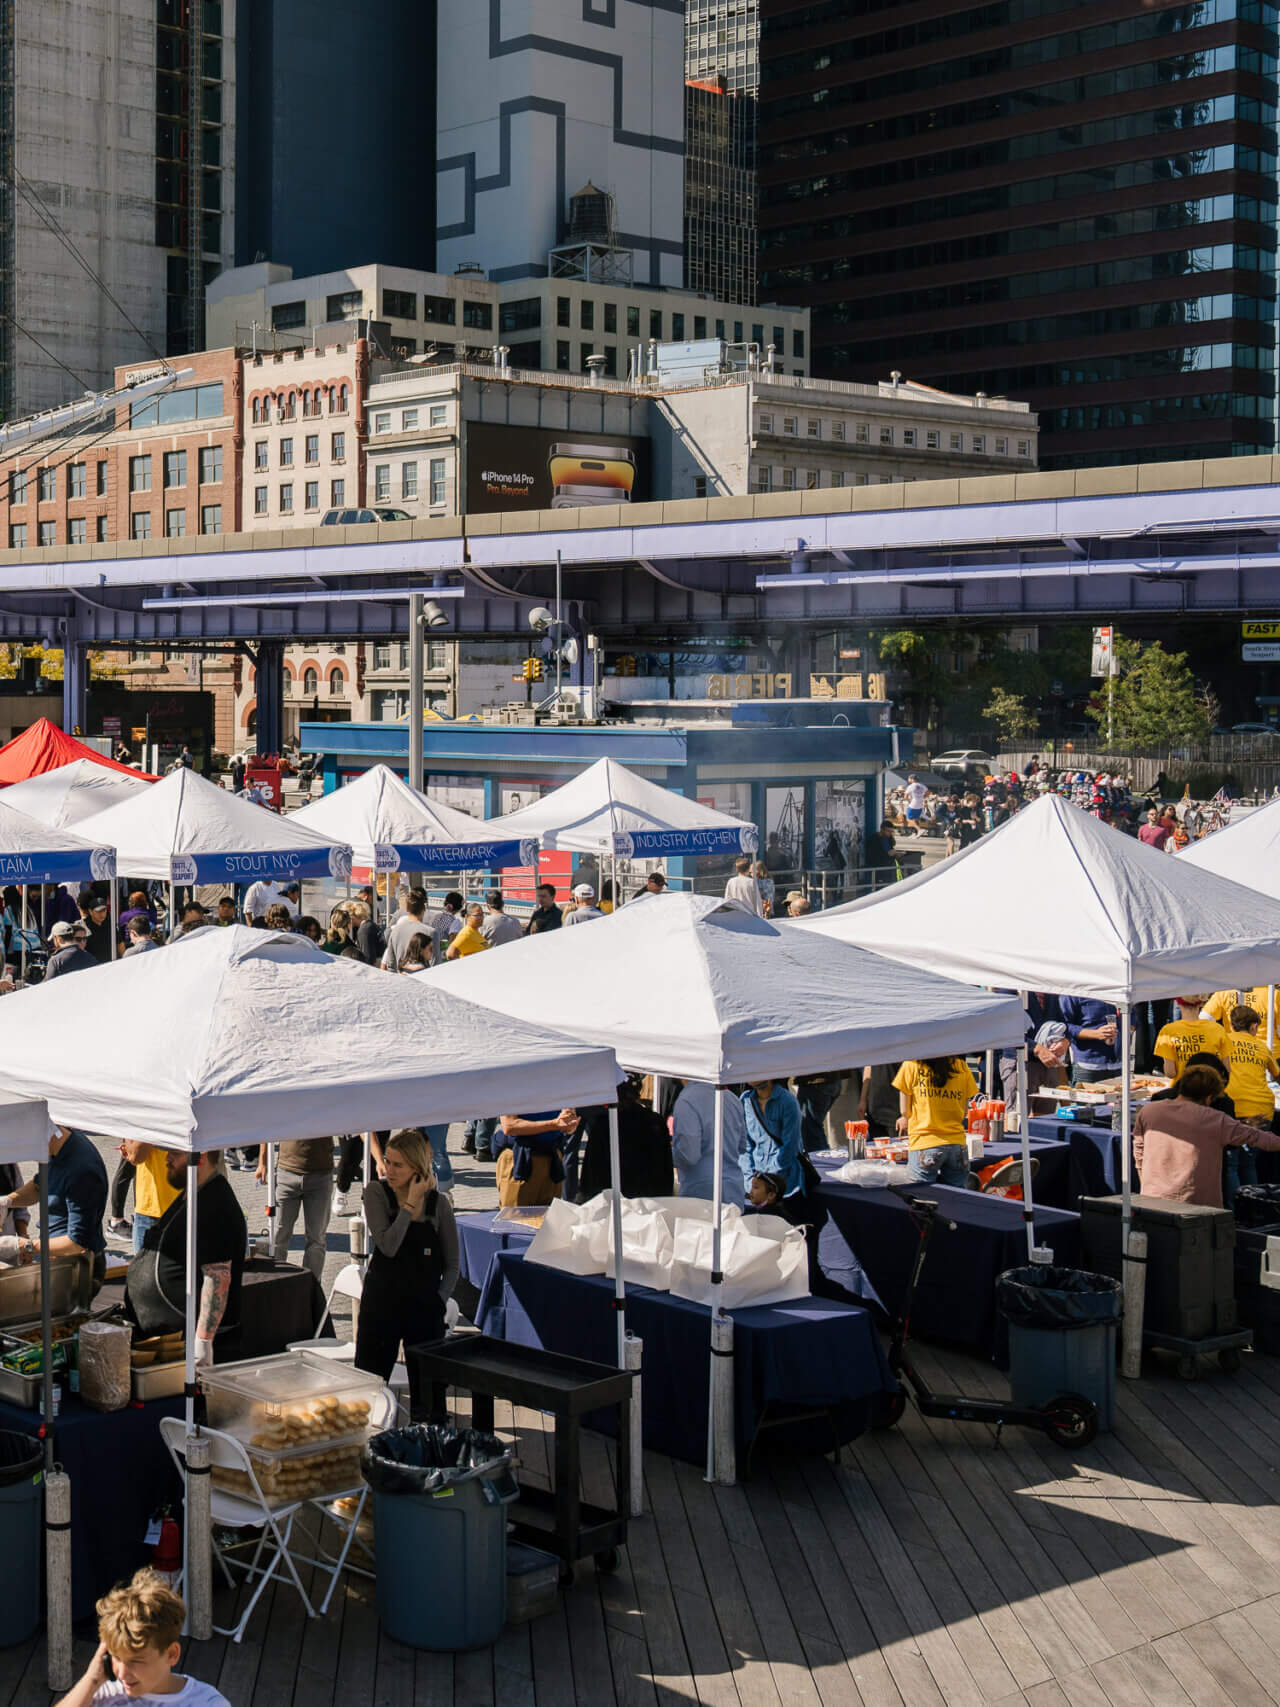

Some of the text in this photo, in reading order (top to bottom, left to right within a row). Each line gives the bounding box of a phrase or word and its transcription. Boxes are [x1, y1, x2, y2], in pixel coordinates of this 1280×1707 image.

[488, 472, 535, 485] iPhone 14 Pro
[1247, 623, 1279, 634] FAST
[636, 832, 737, 849] INDUSTRY KITCHEN
[419, 846, 496, 862] WATERMARK
[225, 853, 301, 872] STOUT NYC
[1174, 1034, 1206, 1044] RAISE
[1175, 1044, 1201, 1053] KIND
